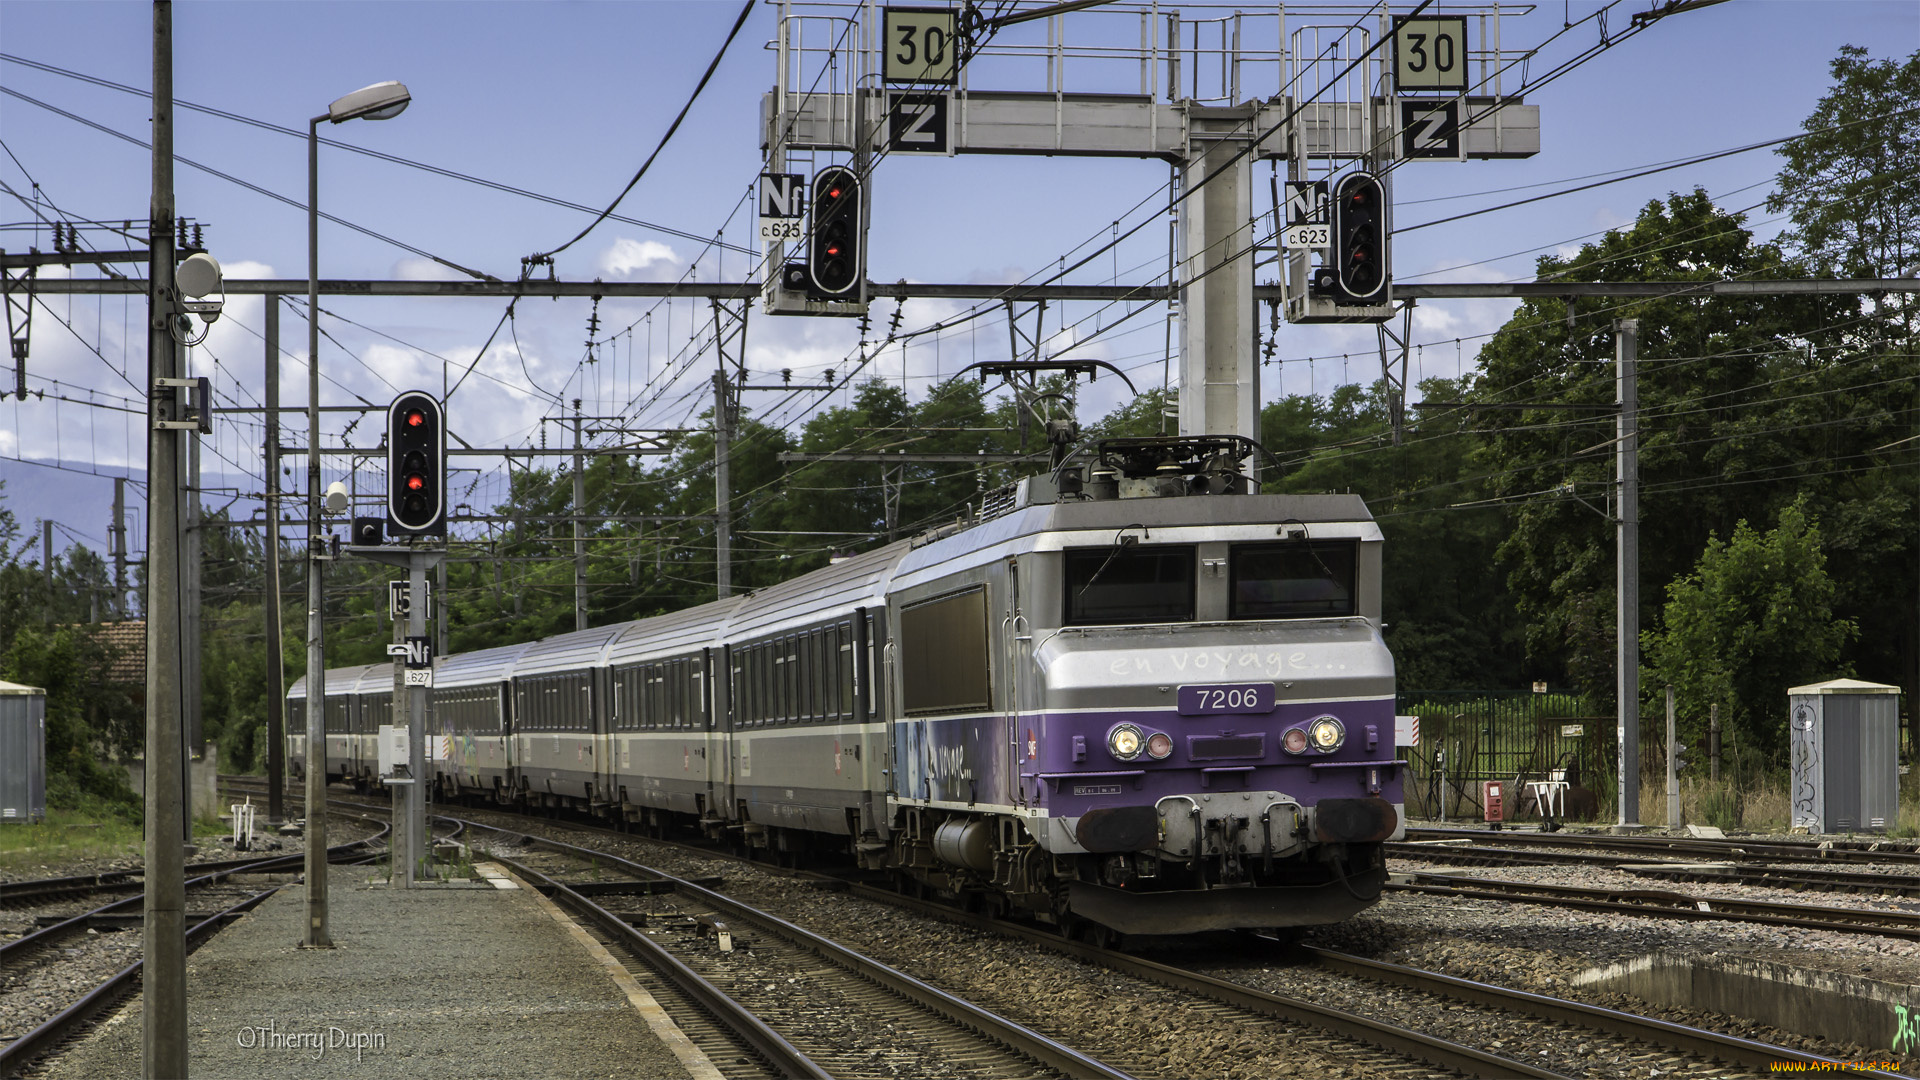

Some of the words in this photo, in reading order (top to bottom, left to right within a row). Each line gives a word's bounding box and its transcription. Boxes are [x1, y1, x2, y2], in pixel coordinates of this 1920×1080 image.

[896, 25, 944, 65] 30
[1406, 33, 1454, 72] 30
[900, 104, 936, 142] Z
[1412, 110, 1448, 149] Z
[760, 177, 803, 215] Nf
[407, 640, 430, 663] Nf
[1110, 657, 1153, 675] en
[1196, 688, 1258, 709] 7206
